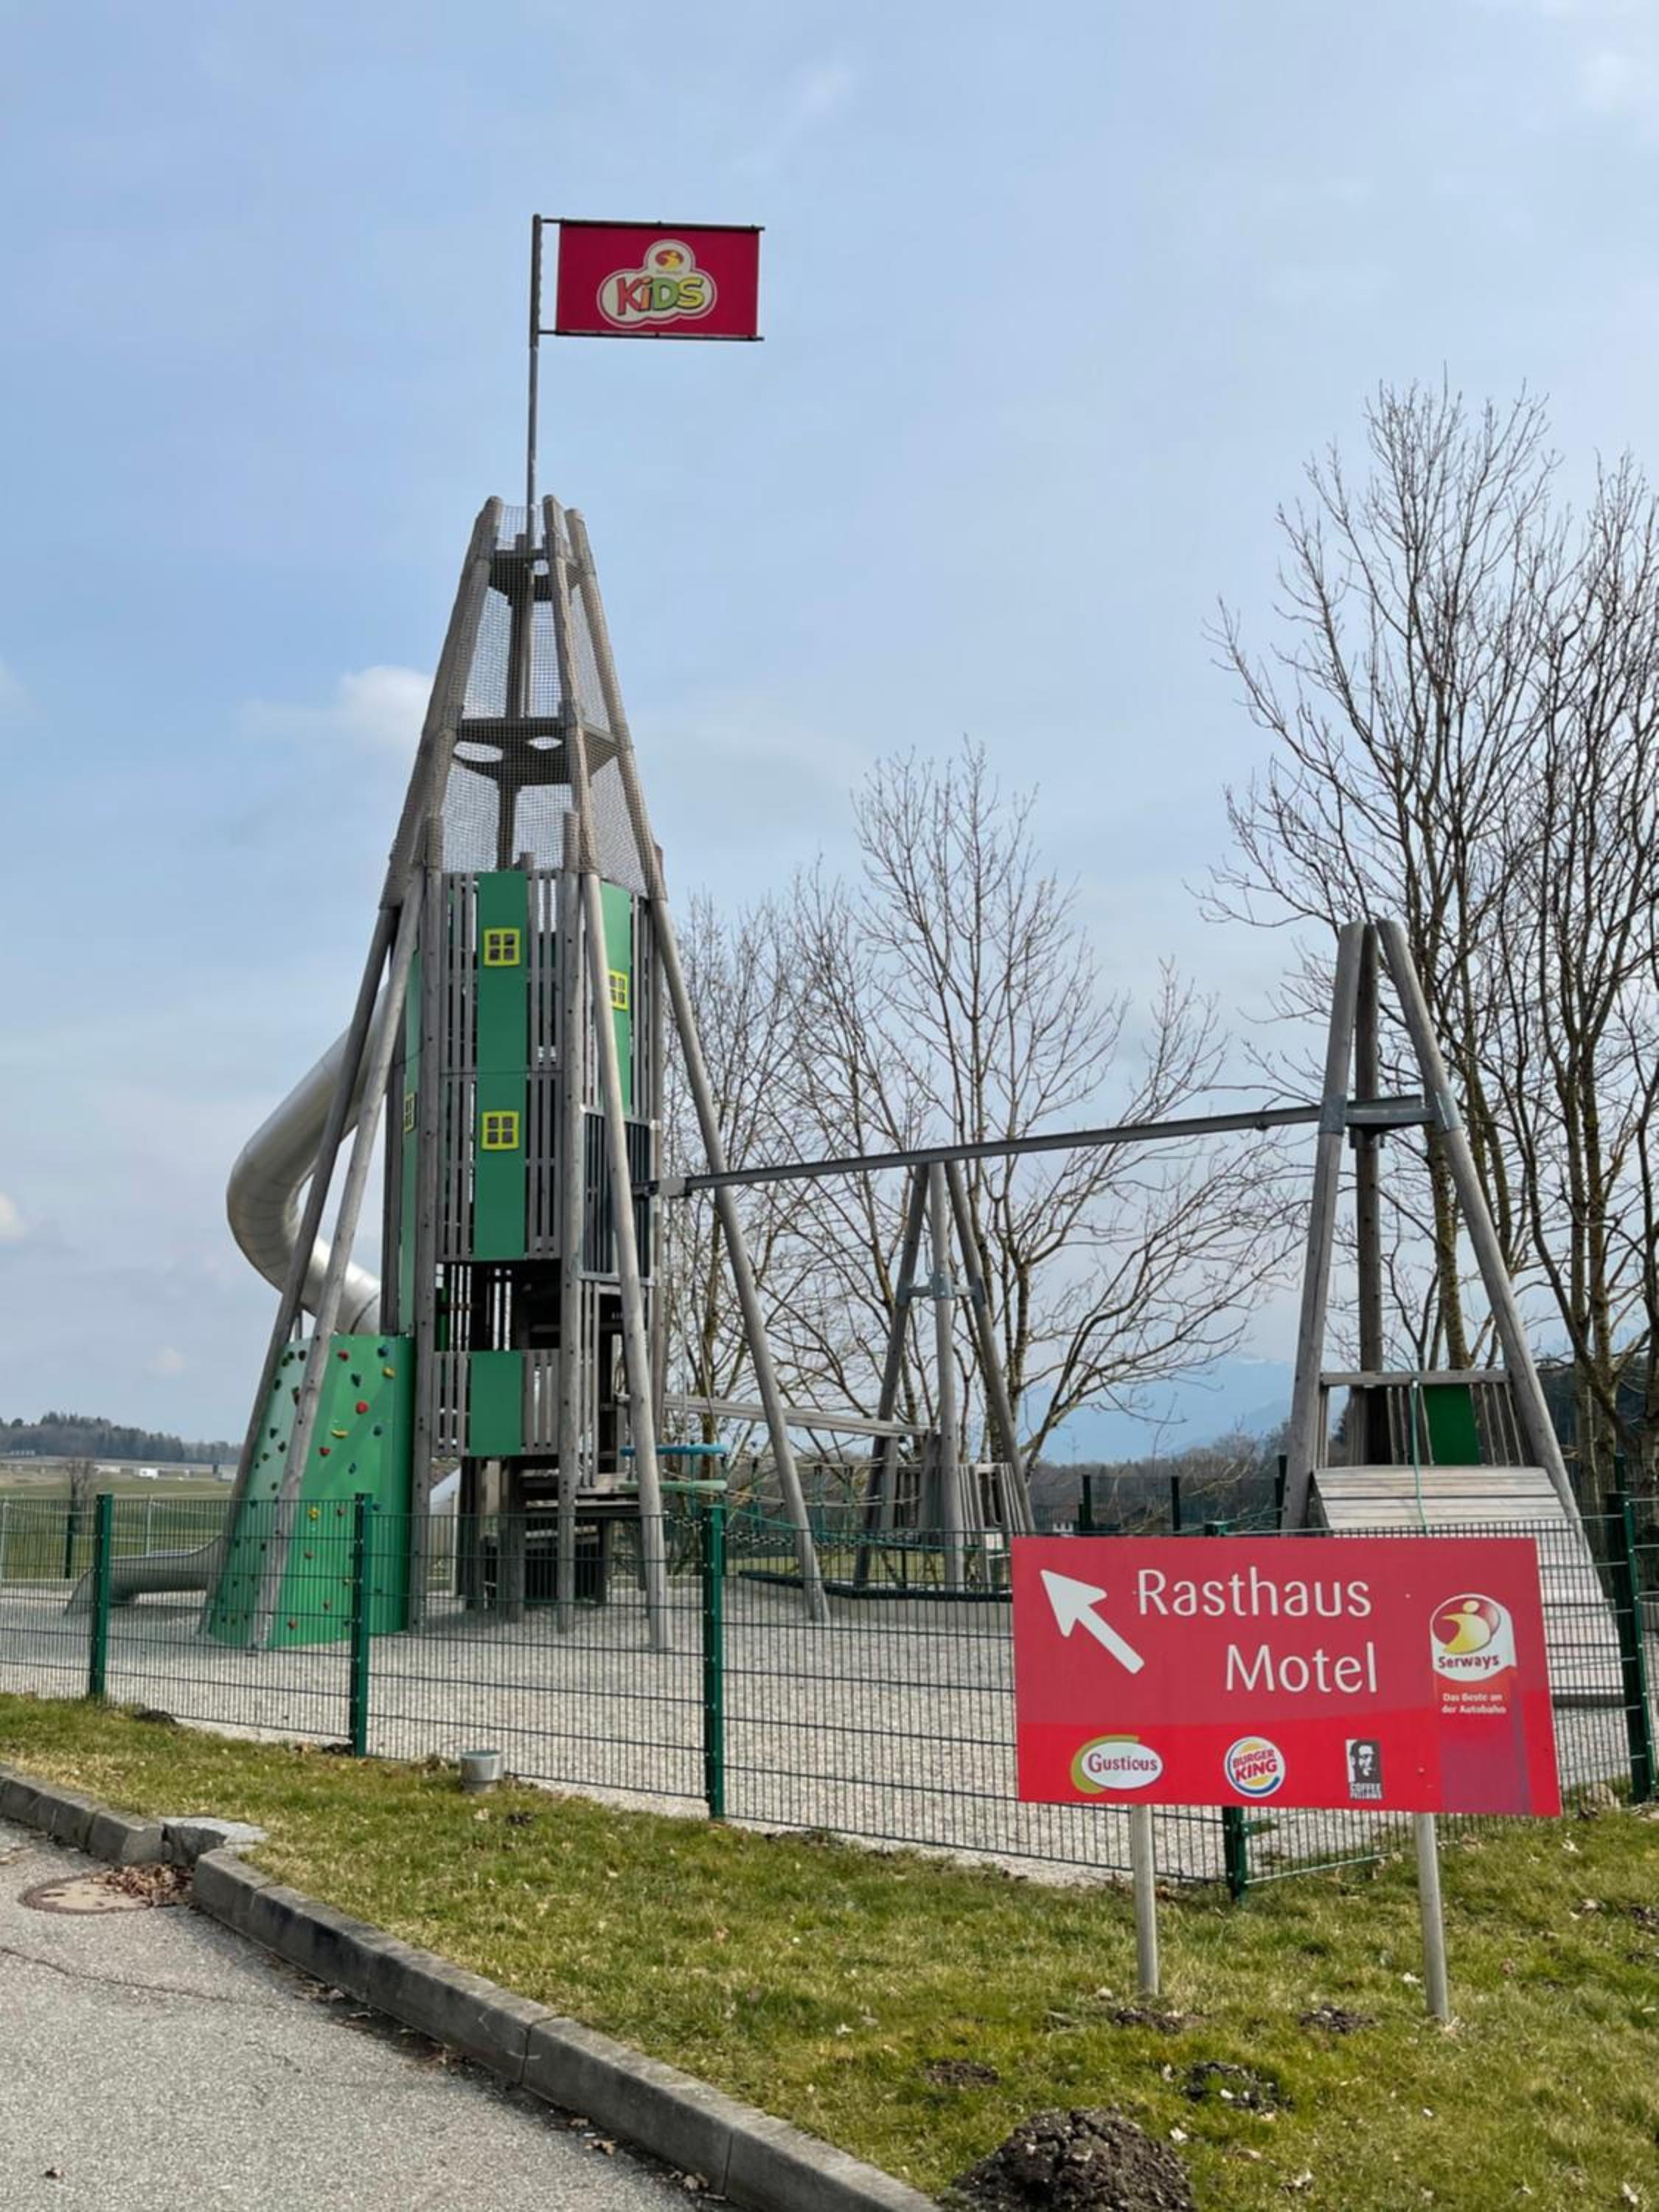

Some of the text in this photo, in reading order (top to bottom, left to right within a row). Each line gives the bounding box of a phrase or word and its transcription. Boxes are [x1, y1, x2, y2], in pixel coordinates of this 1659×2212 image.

[1138, 1565, 1371, 1617] Rasthaus
[1226, 1641, 1378, 1693] Motel
[1439, 1655, 1499, 1669] Serways
[1442, 1693, 1459, 1702] Das
[1462, 1693, 1487, 1702] Beste
[1441, 1705, 1506, 1714] der Autobahn
[1088, 1753, 1158, 1773] Gustious
[1232, 1749, 1275, 1767] BURGER
[1235, 1759, 1278, 1781] KING
